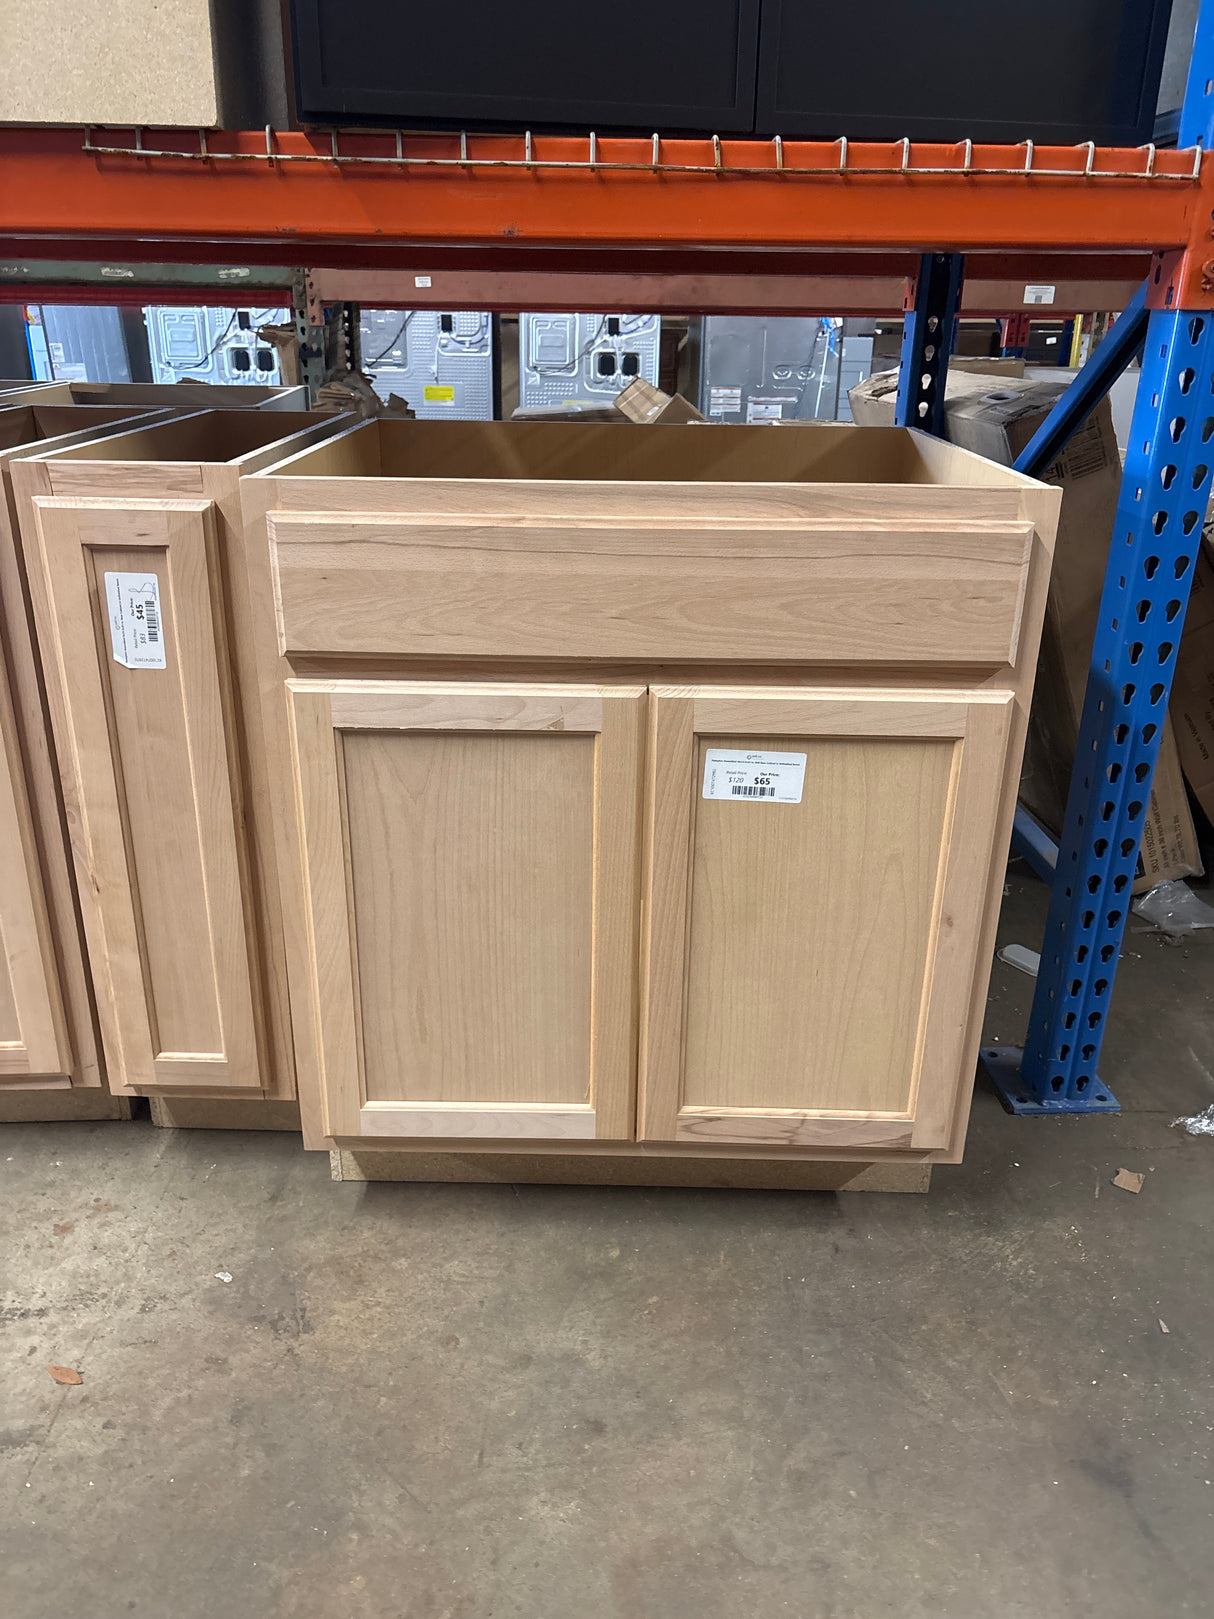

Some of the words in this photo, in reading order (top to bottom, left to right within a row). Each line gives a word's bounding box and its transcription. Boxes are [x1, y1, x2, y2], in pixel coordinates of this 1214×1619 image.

[135, 604, 145, 621] $45
[754, 776, 770, 786] $65
[1150, 859, 1160, 873] SKU
